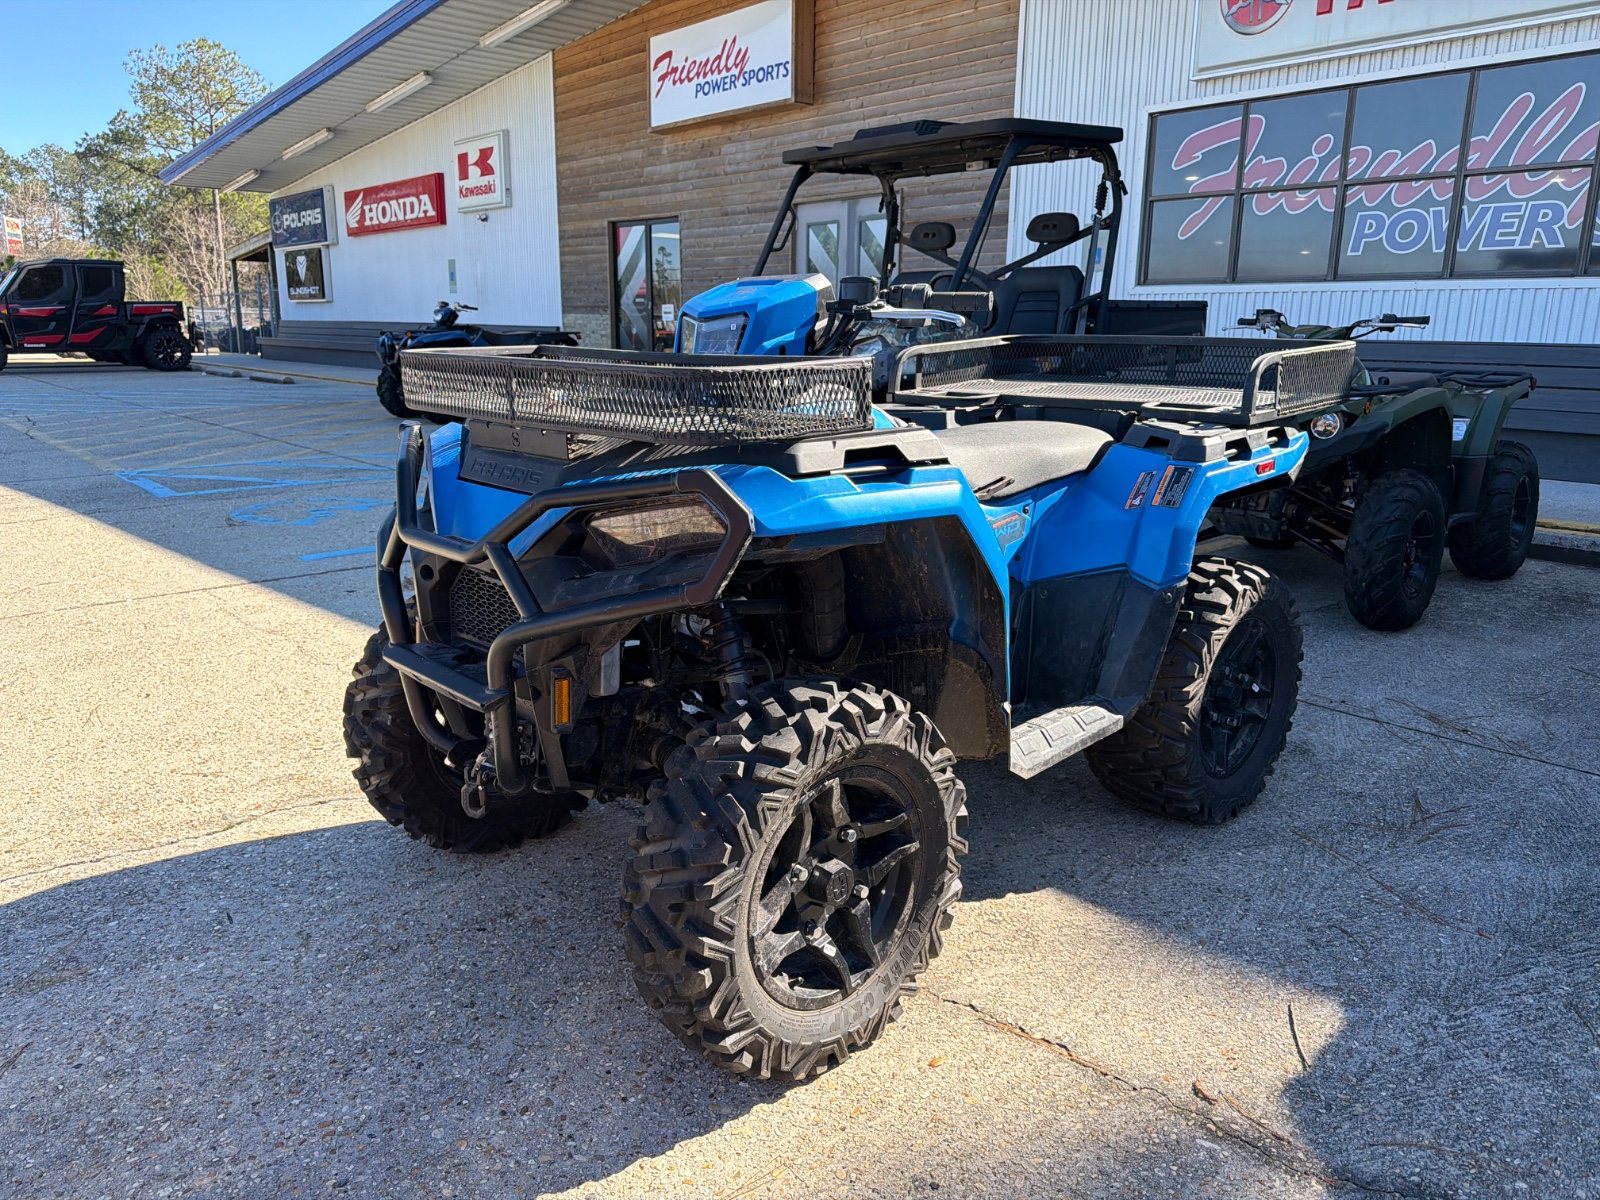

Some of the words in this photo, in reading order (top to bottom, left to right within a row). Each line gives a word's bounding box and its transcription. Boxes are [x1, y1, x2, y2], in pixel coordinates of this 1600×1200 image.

[653, 35, 750, 98] Friendly
[695, 74, 738, 98] POWER
[741, 61, 790, 87] SPORTS
[459, 180, 496, 199] Kawasaki
[283, 208, 322, 230] POLARIS
[363, 194, 436, 227] HONDA
[1347, 199, 1566, 257] POWER
[289, 286, 320, 295] SLINGSHOT
[471, 458, 544, 486] POLARIS
[994, 519, 1021, 538] WD
[829, 991, 876, 1034] GRIP
